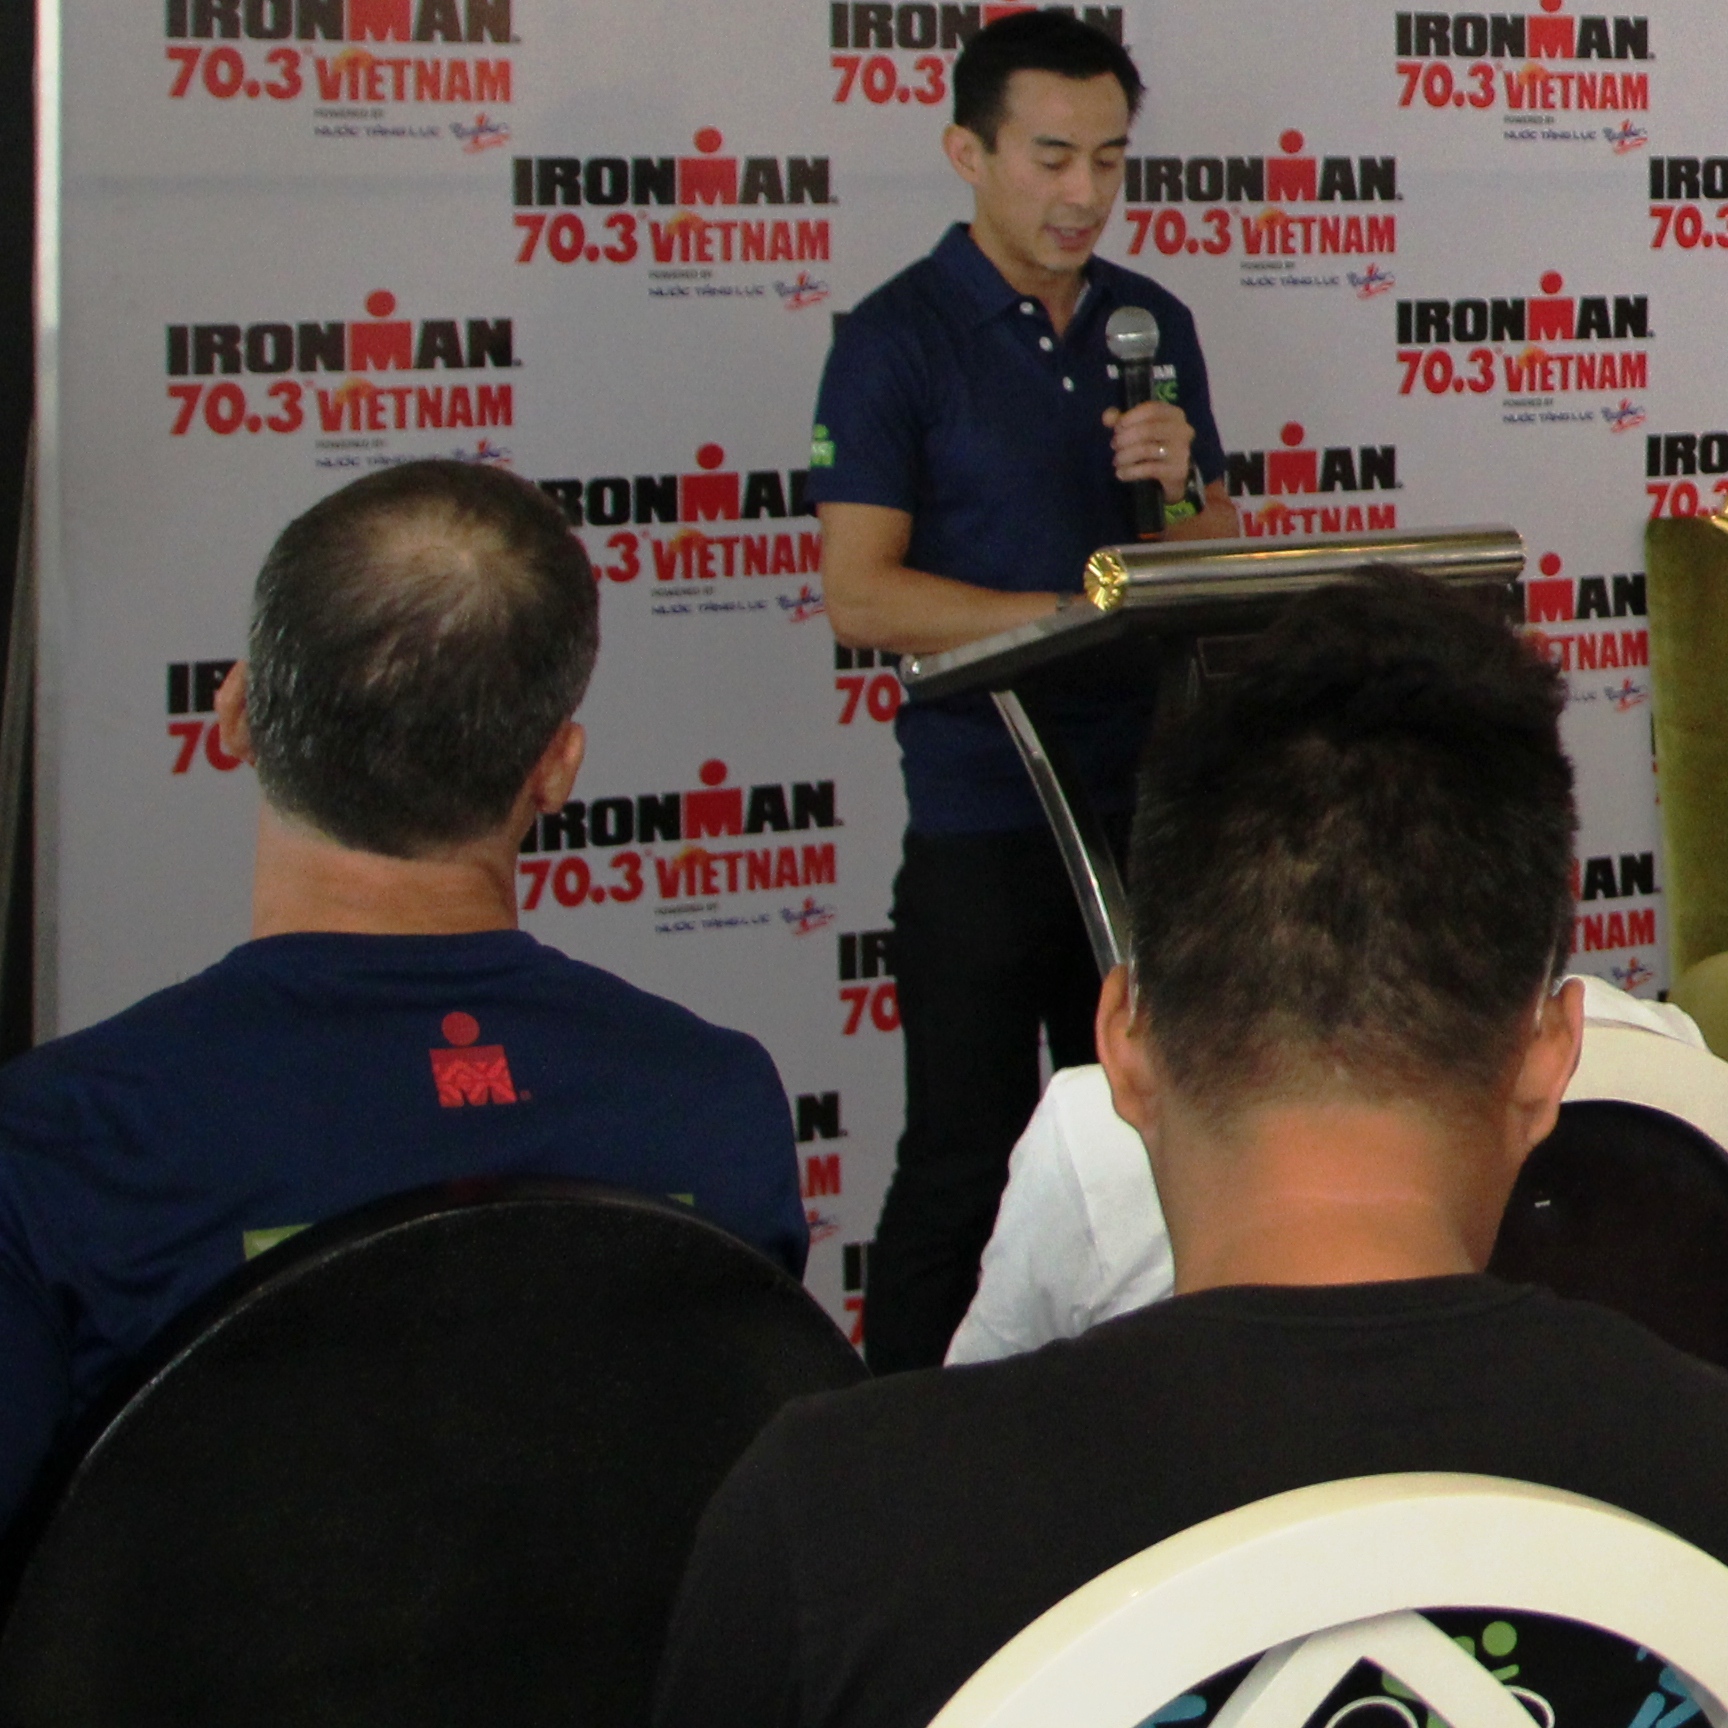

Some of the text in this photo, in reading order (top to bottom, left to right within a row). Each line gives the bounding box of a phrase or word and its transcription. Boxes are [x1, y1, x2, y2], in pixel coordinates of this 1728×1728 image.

[829, 2, 1123, 49] IRONN
[1396, 11, 1647, 60] IRONMAN
[165, 46, 511, 103] 70.3 VIETNAM
[830, 54, 946, 105] 70.3
[1396, 61, 1647, 110] 70.3 VIETNAM
[513, 155, 830, 206] IRONMAN
[1125, 156, 1395, 203] IRONMAN
[513, 212, 831, 265] 70.3 VIETNAM
[1125, 208, 1395, 256] 70.3 VIETNAM
[1396, 295, 1647, 345] IRONMAN
[167, 318, 514, 377] IRONMAN
[1396, 348, 1647, 395] 70.3 VIETNAM
[167, 380, 514, 436] 70.3 VIETNAM
[519, 843, 837, 911] 70.3 VIETNAM
